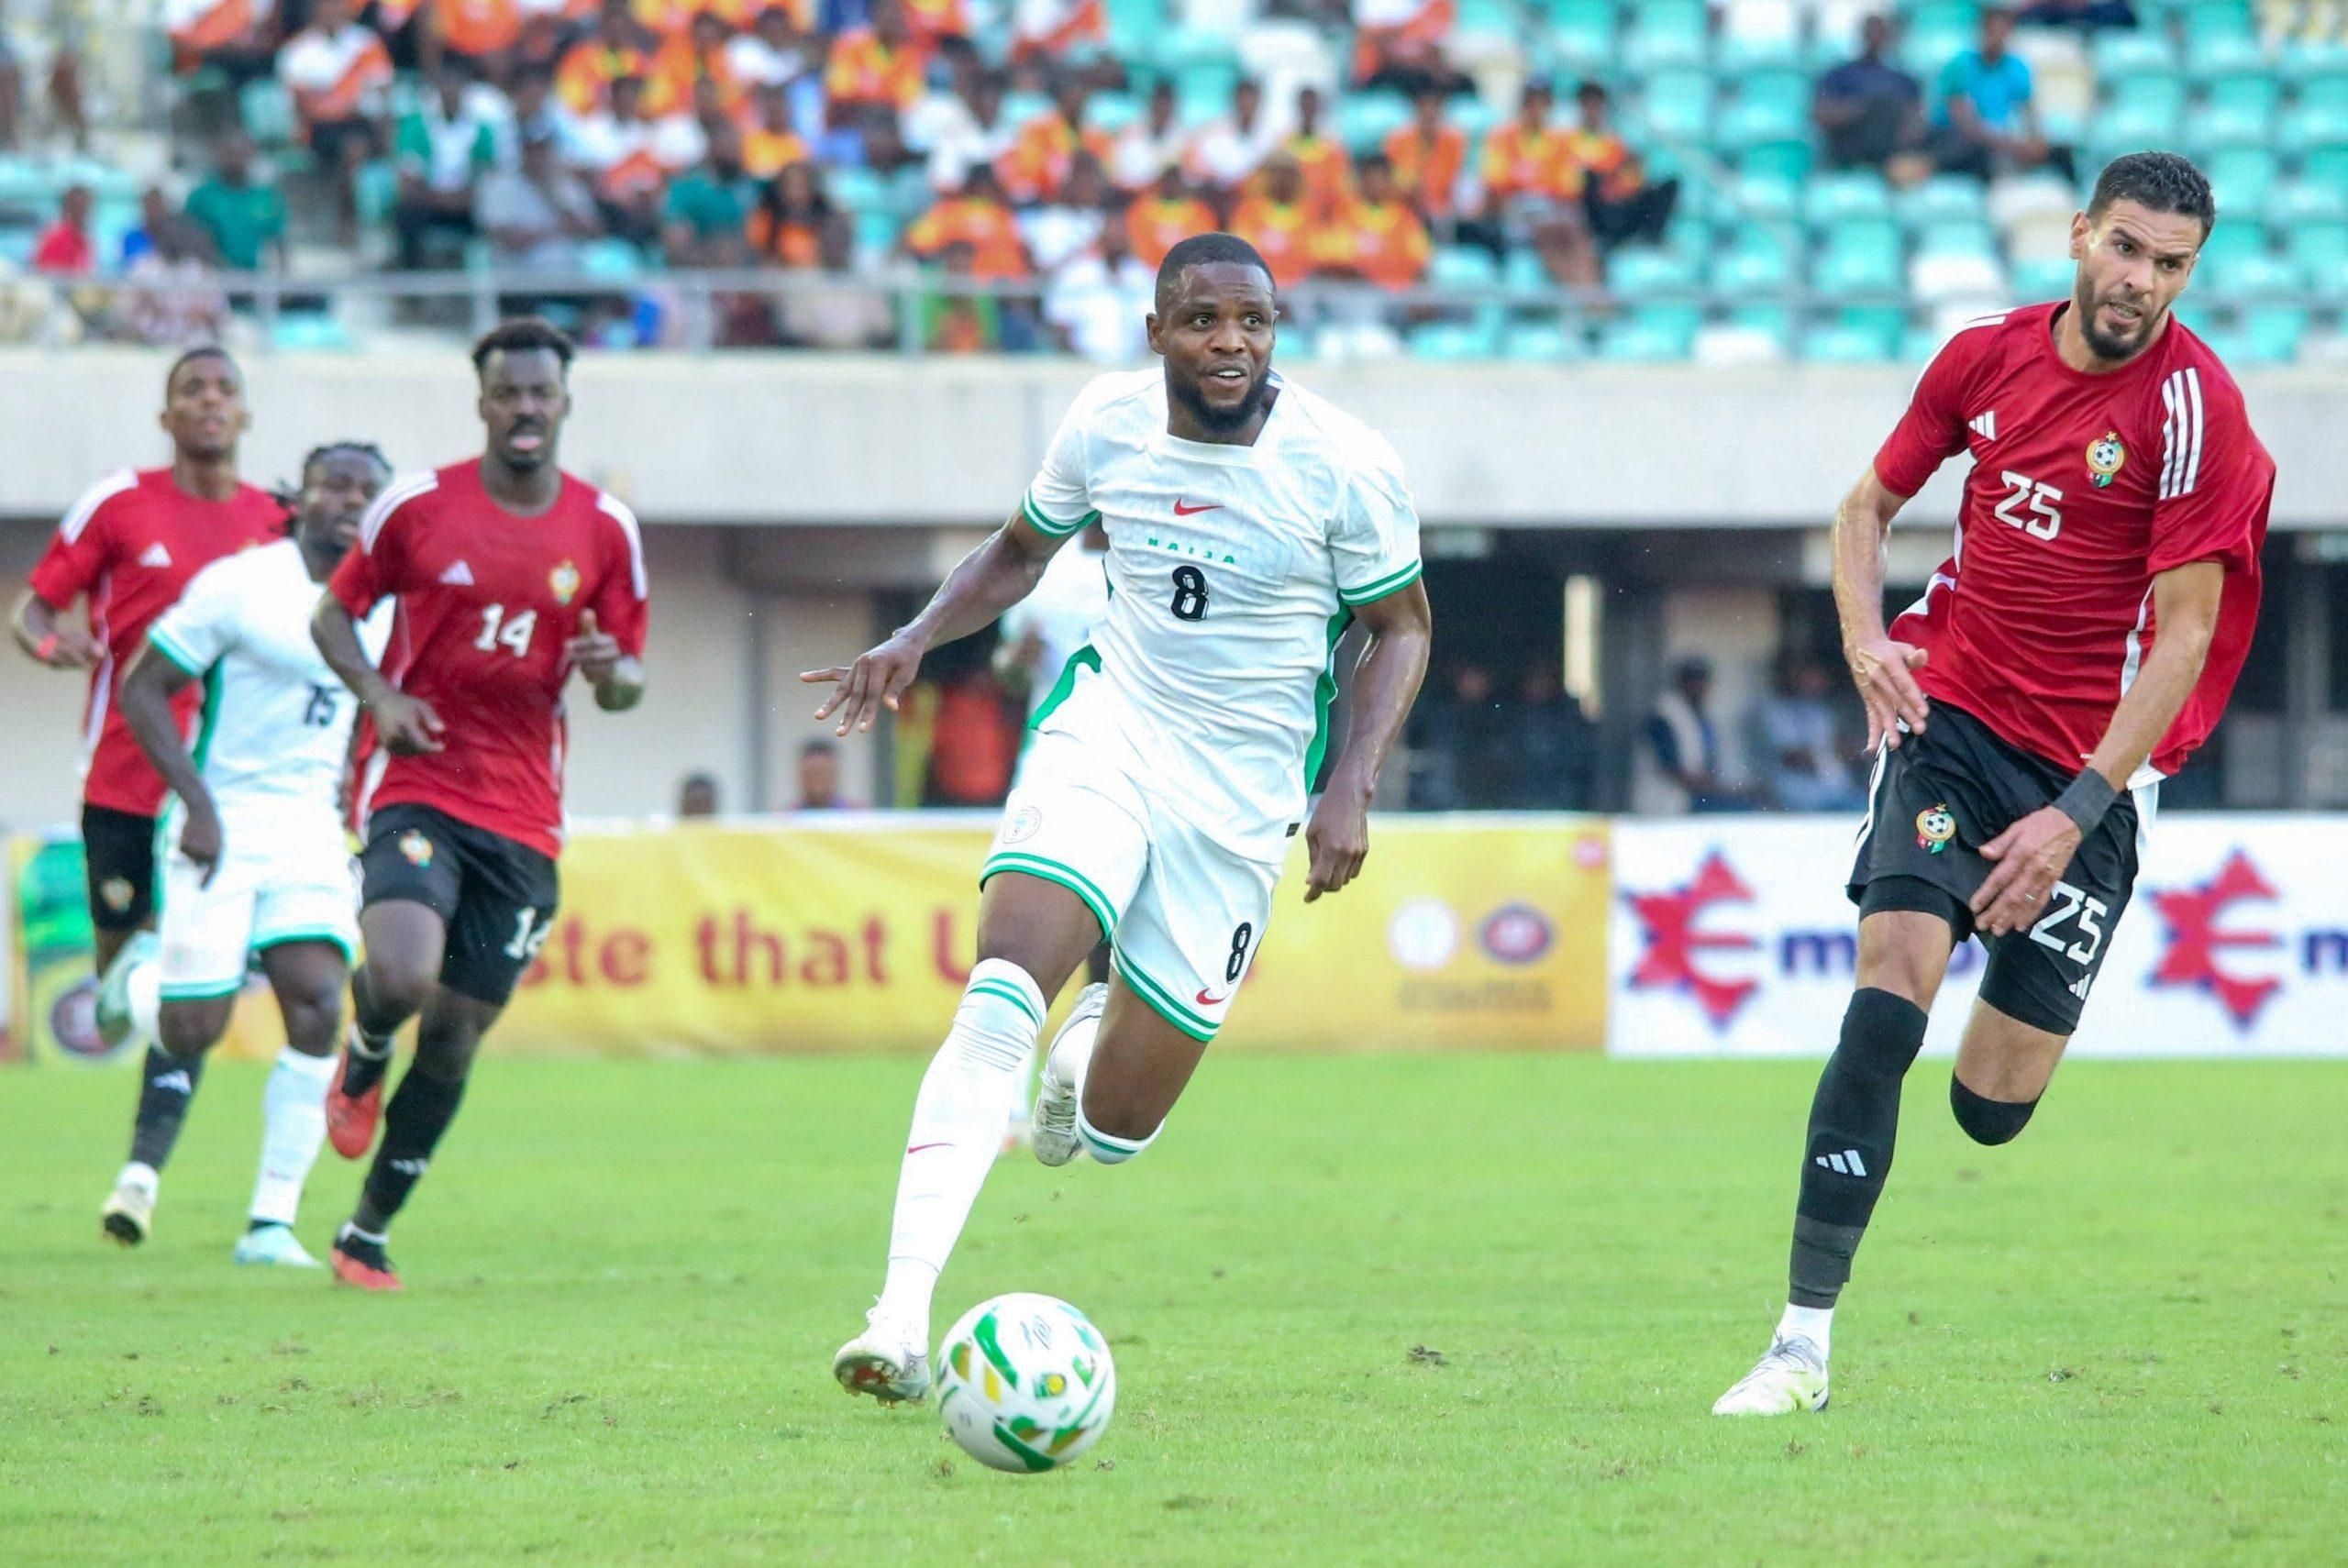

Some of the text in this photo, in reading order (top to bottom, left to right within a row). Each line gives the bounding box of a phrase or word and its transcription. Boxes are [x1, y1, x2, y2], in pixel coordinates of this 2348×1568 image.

[1994, 469, 2065, 542] 25
[1147, 536, 1235, 565] NAIJA
[1170, 564, 1210, 623] 8
[473, 602, 538, 658] 14
[696, 908, 887, 986] that
[1225, 921, 1252, 985] 8
[2027, 879, 2109, 966] 25
